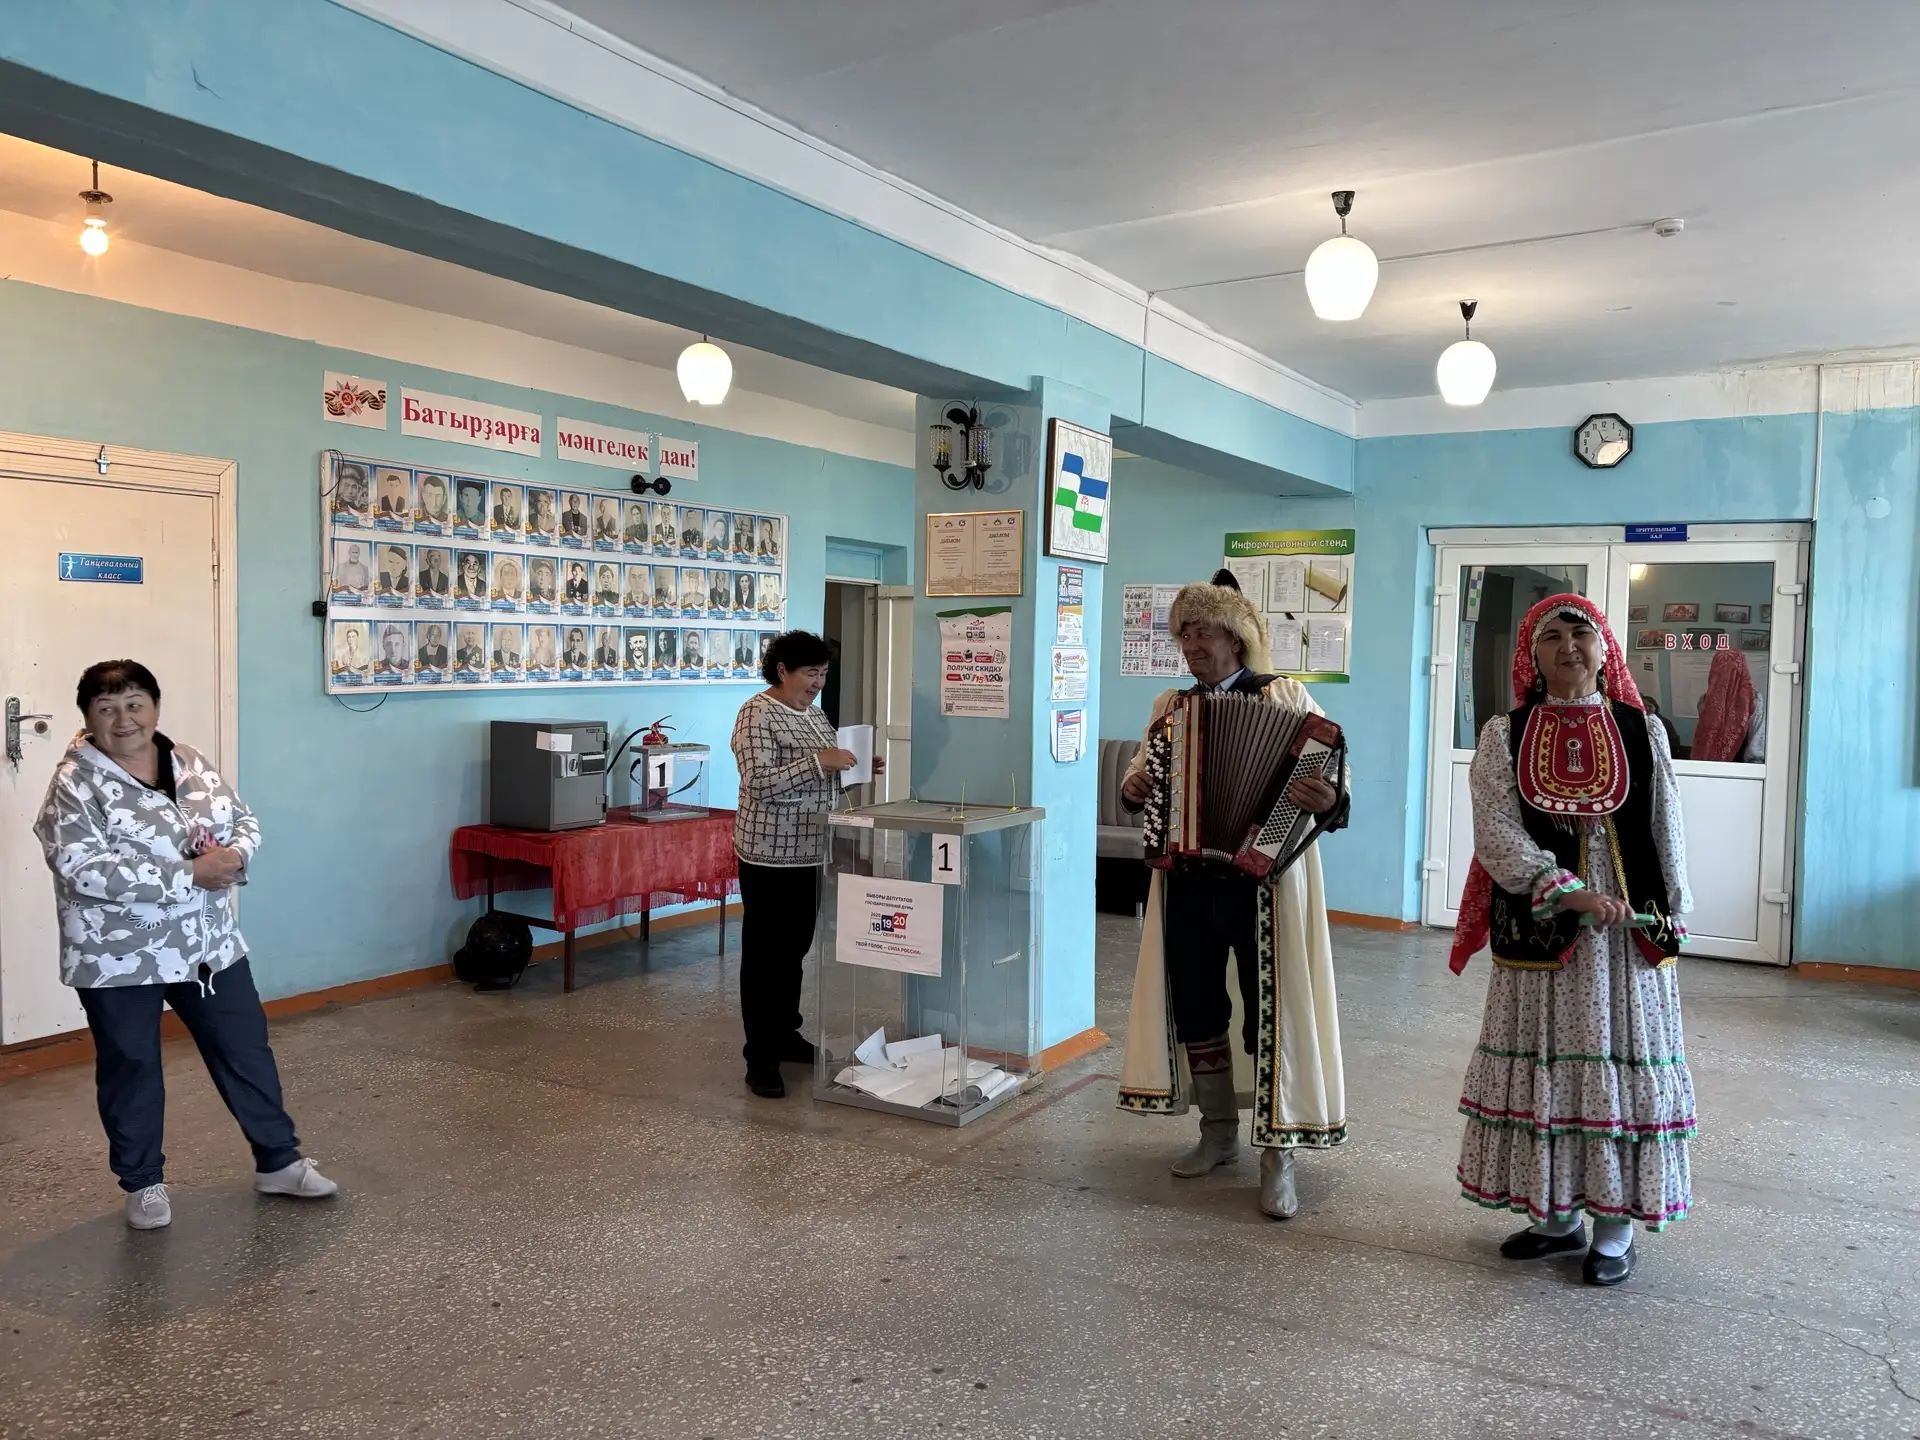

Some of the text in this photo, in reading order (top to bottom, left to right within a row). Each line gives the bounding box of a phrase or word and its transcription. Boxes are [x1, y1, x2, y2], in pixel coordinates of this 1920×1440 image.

[403, 397, 696, 468] Батырҙарға мәңгелек дан!
[1231, 538, 1347, 551] Информационный стенд
[80, 557, 139, 569] Танцевальный
[97, 572, 122, 580] класс
[1665, 633, 1730, 650] ВХОД
[946, 664, 1003, 673] ПОЛУЧИ СКИДКУ
[655, 761, 666, 787] 1
[938, 843, 953, 871] 1
[872, 922, 881, 932] 18
[882, 919, 892, 929] 19
[893, 916, 905, 926] 20
